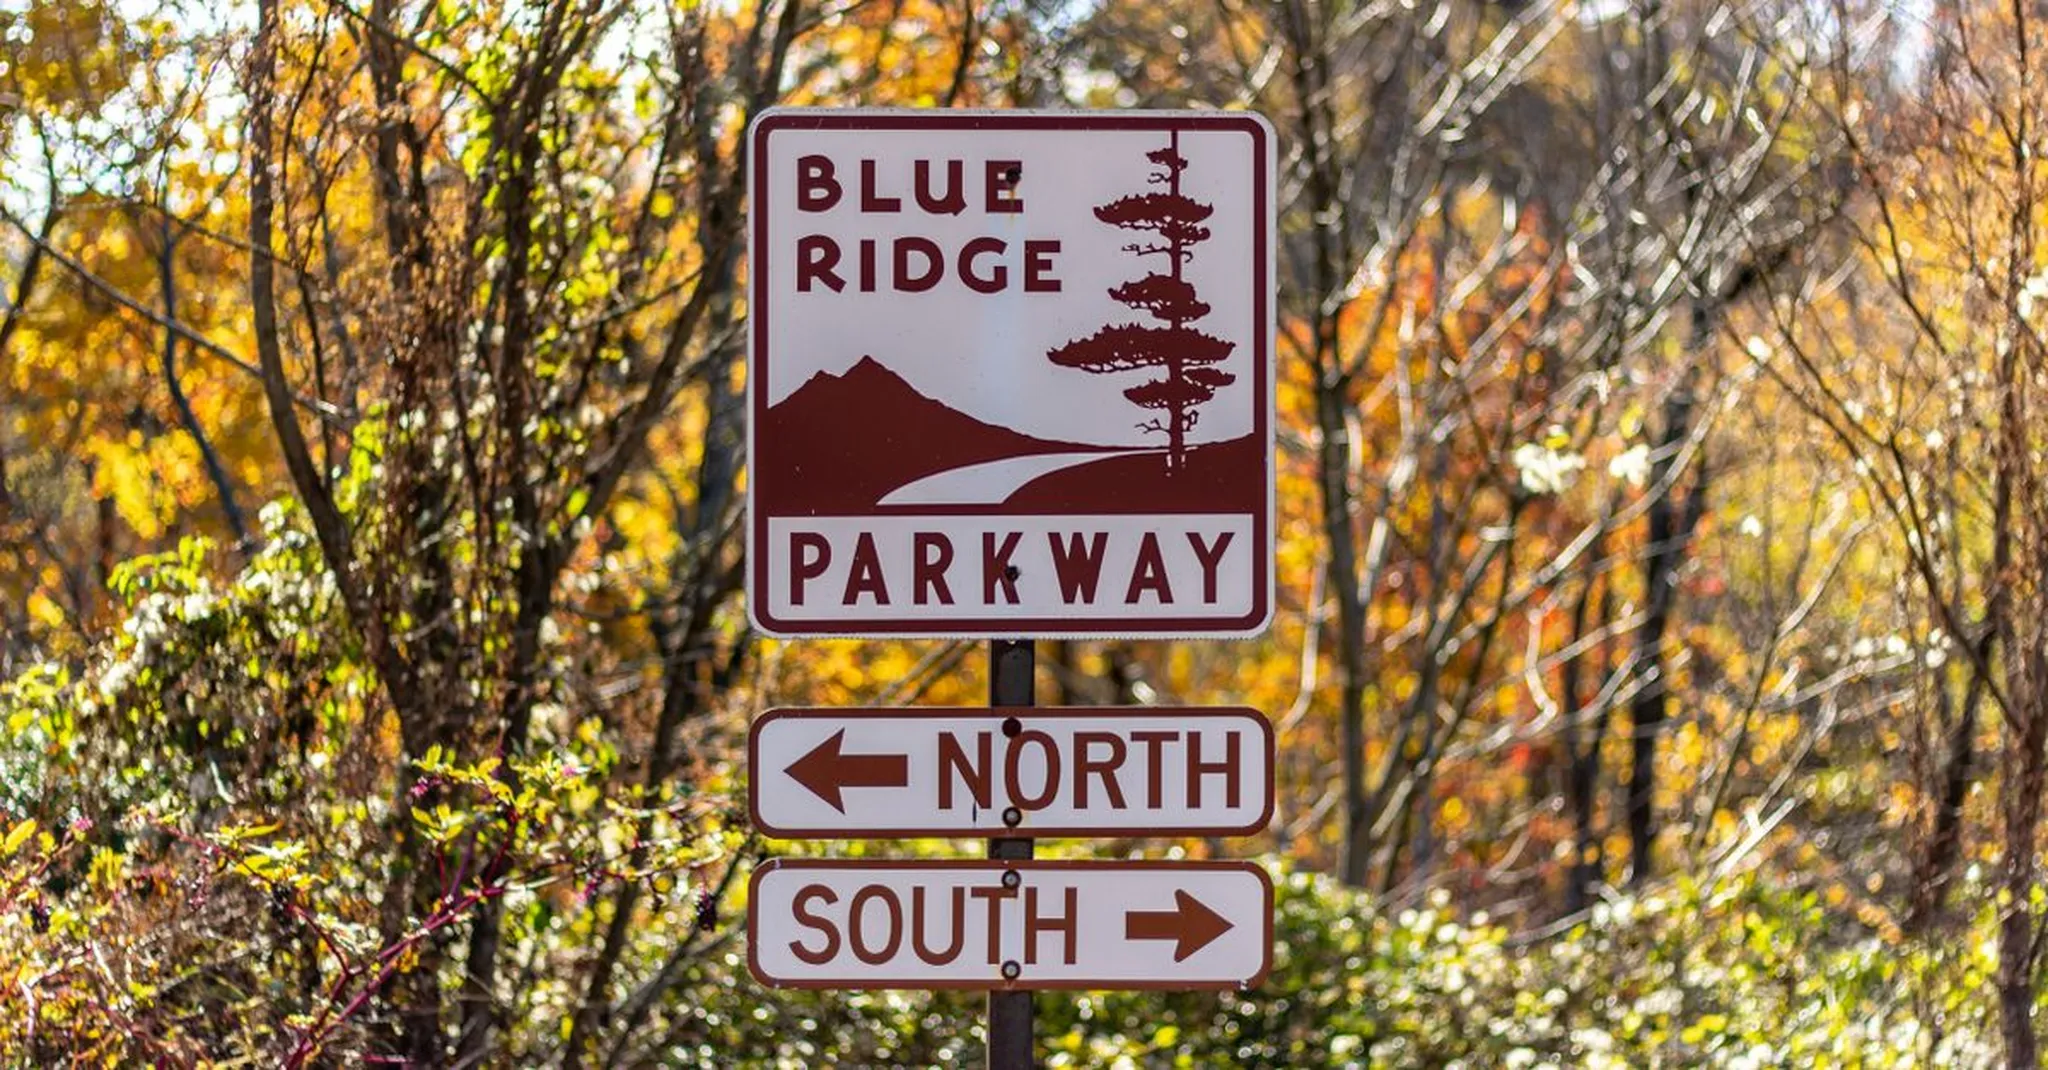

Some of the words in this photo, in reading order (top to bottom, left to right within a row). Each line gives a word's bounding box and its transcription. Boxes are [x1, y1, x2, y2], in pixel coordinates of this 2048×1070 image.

[796, 154, 1025, 216] BLUE
[796, 234, 1062, 295] RIDGE
[789, 531, 1234, 606] PARKWAY
[937, 729, 1242, 811] NORTH
[788, 884, 1078, 966] SOUTH
